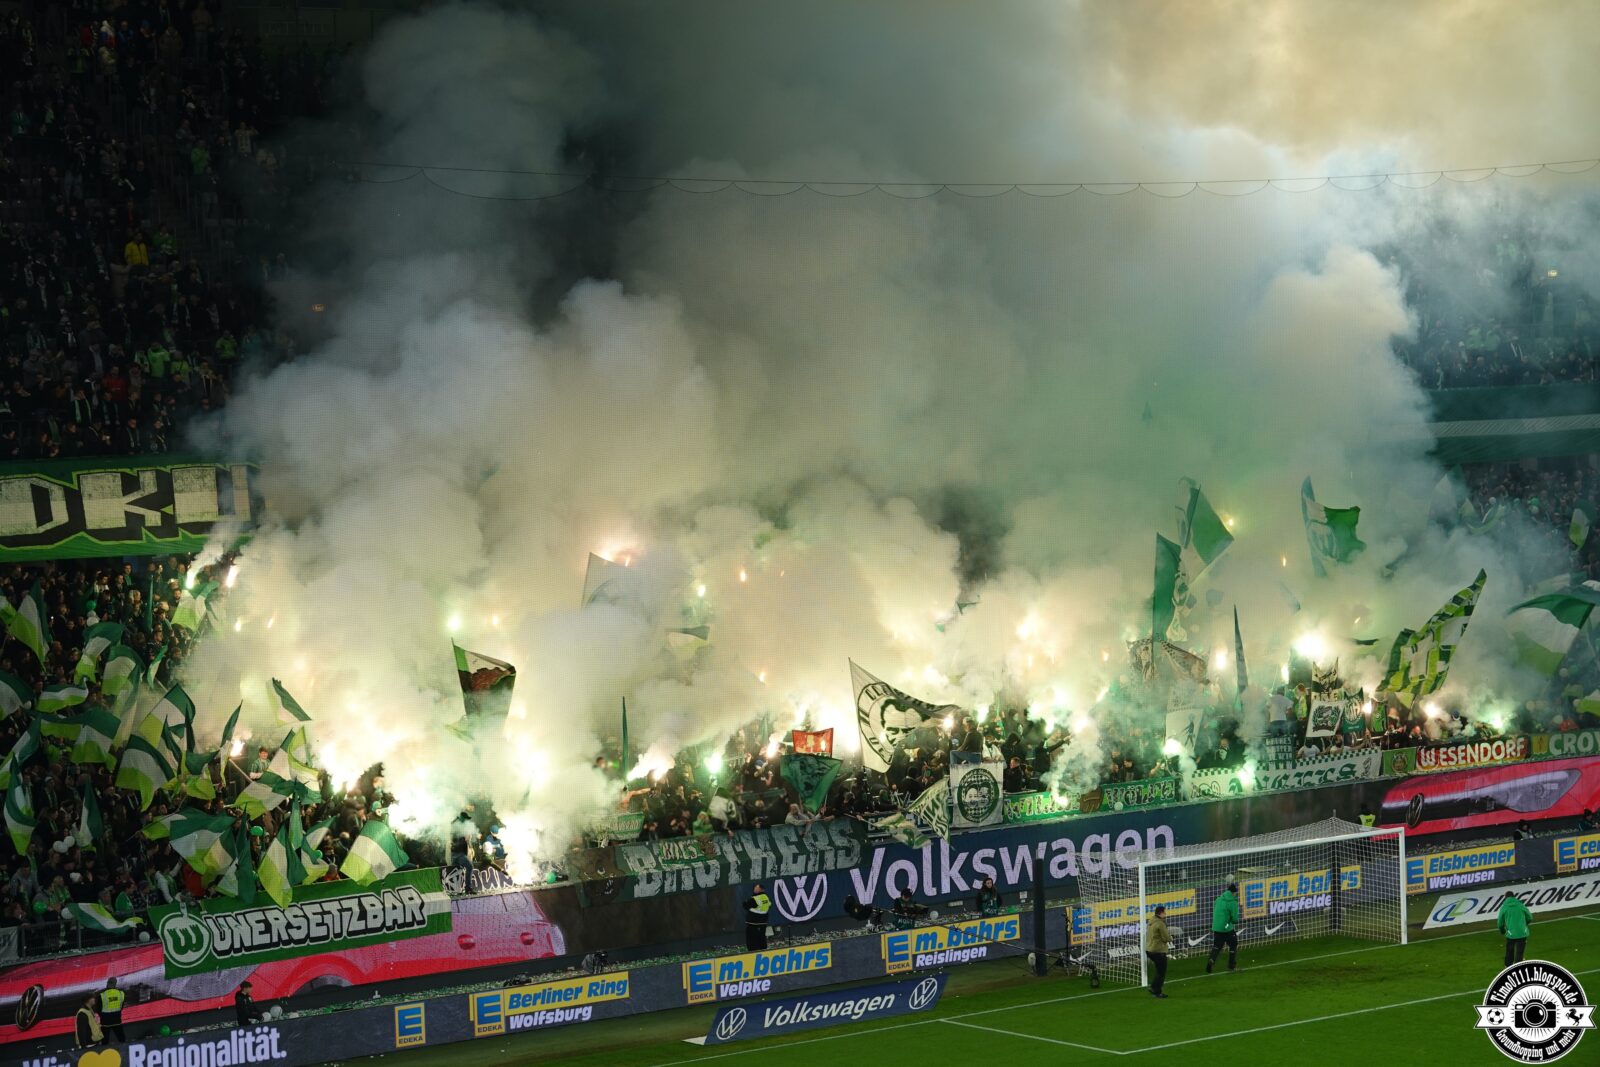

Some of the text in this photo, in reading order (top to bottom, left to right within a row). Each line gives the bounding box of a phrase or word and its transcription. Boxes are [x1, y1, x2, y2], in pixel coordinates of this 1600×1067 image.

[1420, 738, 1525, 766] WESENDORF
[850, 823, 1175, 904] Volkswagen
[1429, 849, 1514, 874] Eisbrenner
[1430, 870, 1495, 889] Weyhausen
[1269, 894, 1332, 915] Vorsfelde
[206, 888, 425, 955] UNERSETZBAR
[915, 919, 1018, 952] m. bahrs
[719, 948, 829, 982] m. bahrs
[916, 946, 987, 967] Reislingen
[508, 979, 627, 1009] Berliner Ring
[720, 978, 771, 998] Velpke
[509, 1006, 592, 1030] Wolfsburg
[763, 992, 895, 1028] Volkswagen
[398, 1036, 424, 1045] EDEKA
[477, 1024, 503, 1033] EDEKA
[128, 1027, 287, 1067] Regionalität.
